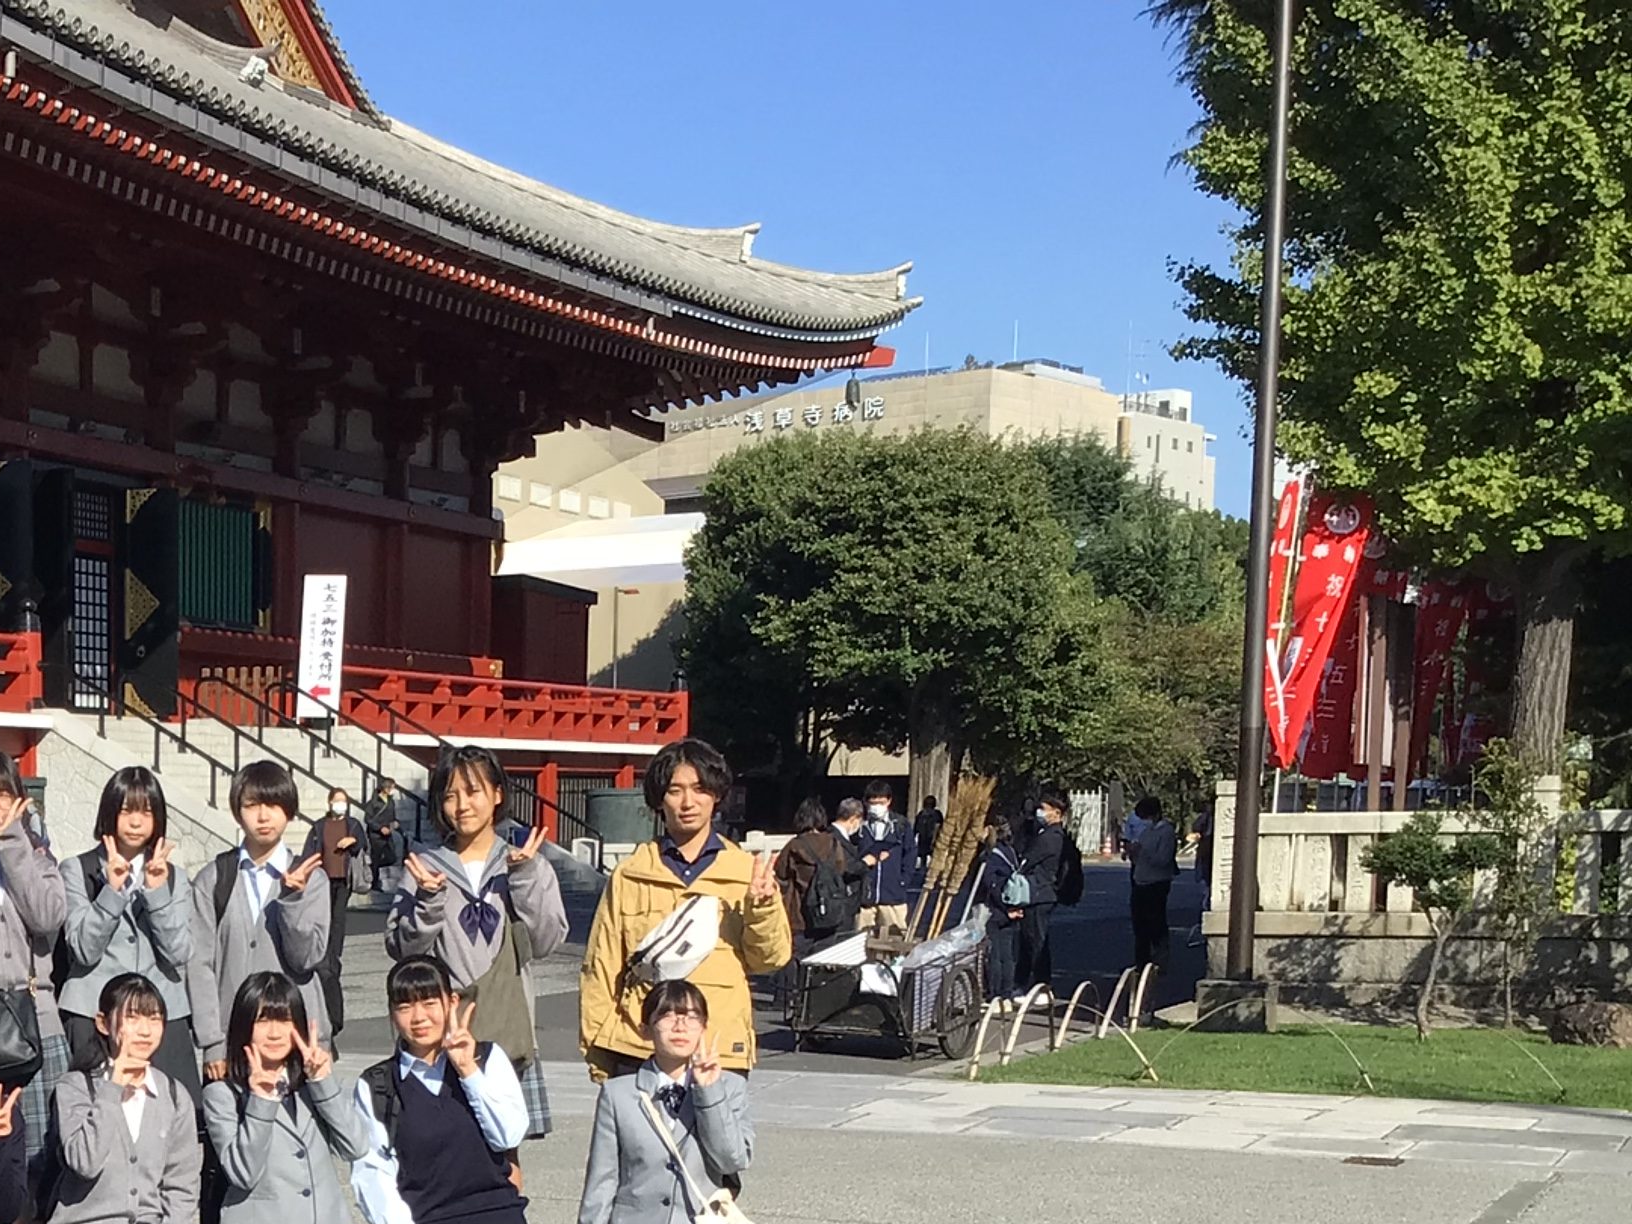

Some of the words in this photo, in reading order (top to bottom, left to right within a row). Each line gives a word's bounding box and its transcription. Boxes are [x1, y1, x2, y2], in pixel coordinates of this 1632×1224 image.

[744, 396, 884, 434] 浅草寺病院
